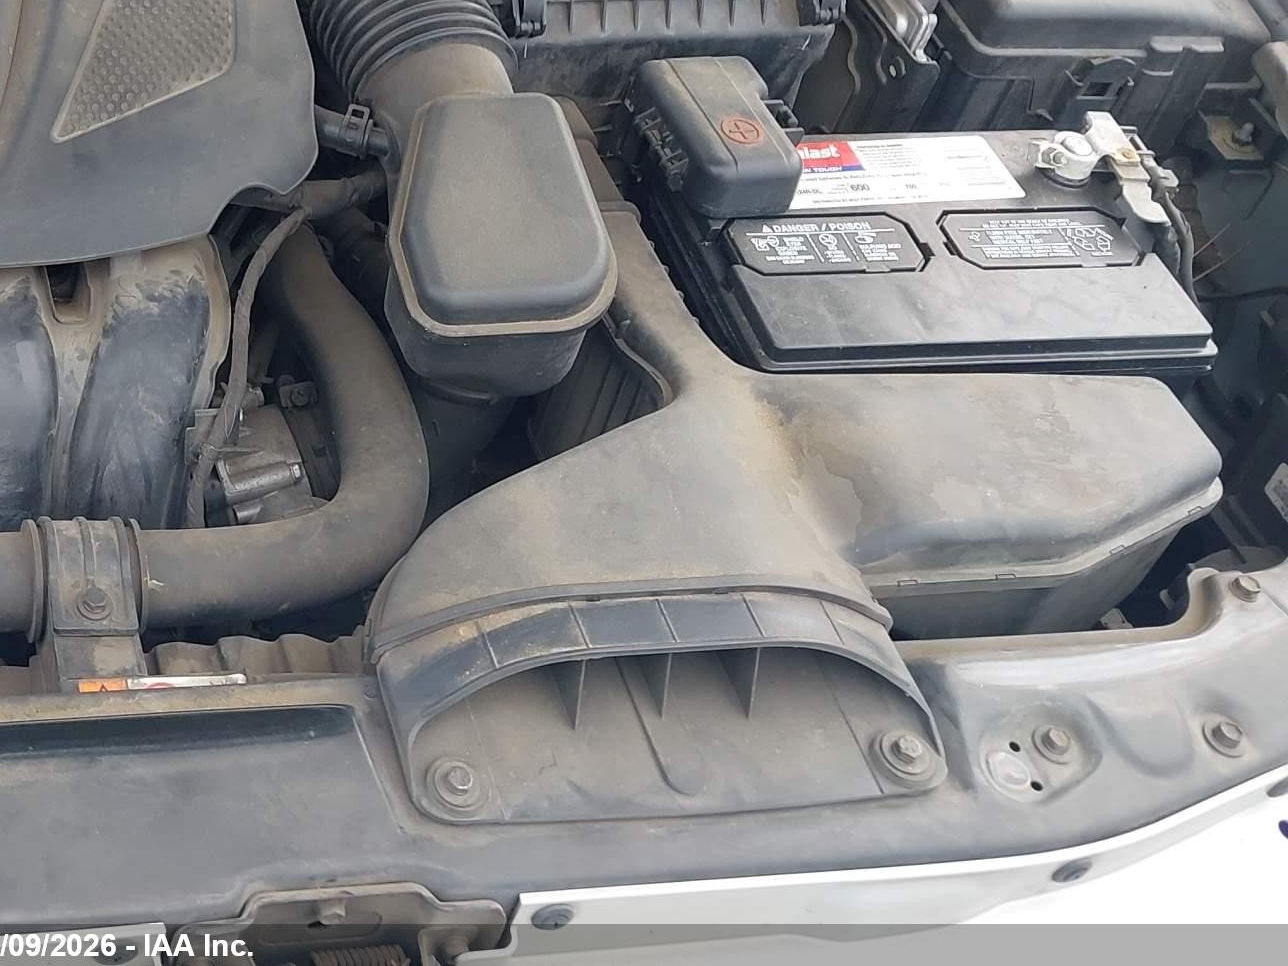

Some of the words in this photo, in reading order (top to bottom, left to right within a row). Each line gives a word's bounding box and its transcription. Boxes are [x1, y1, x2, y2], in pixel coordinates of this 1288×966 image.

[850, 182, 871, 192] 600
[772, 223, 819, 233] DANGER
[828, 221, 872, 230] POISON
